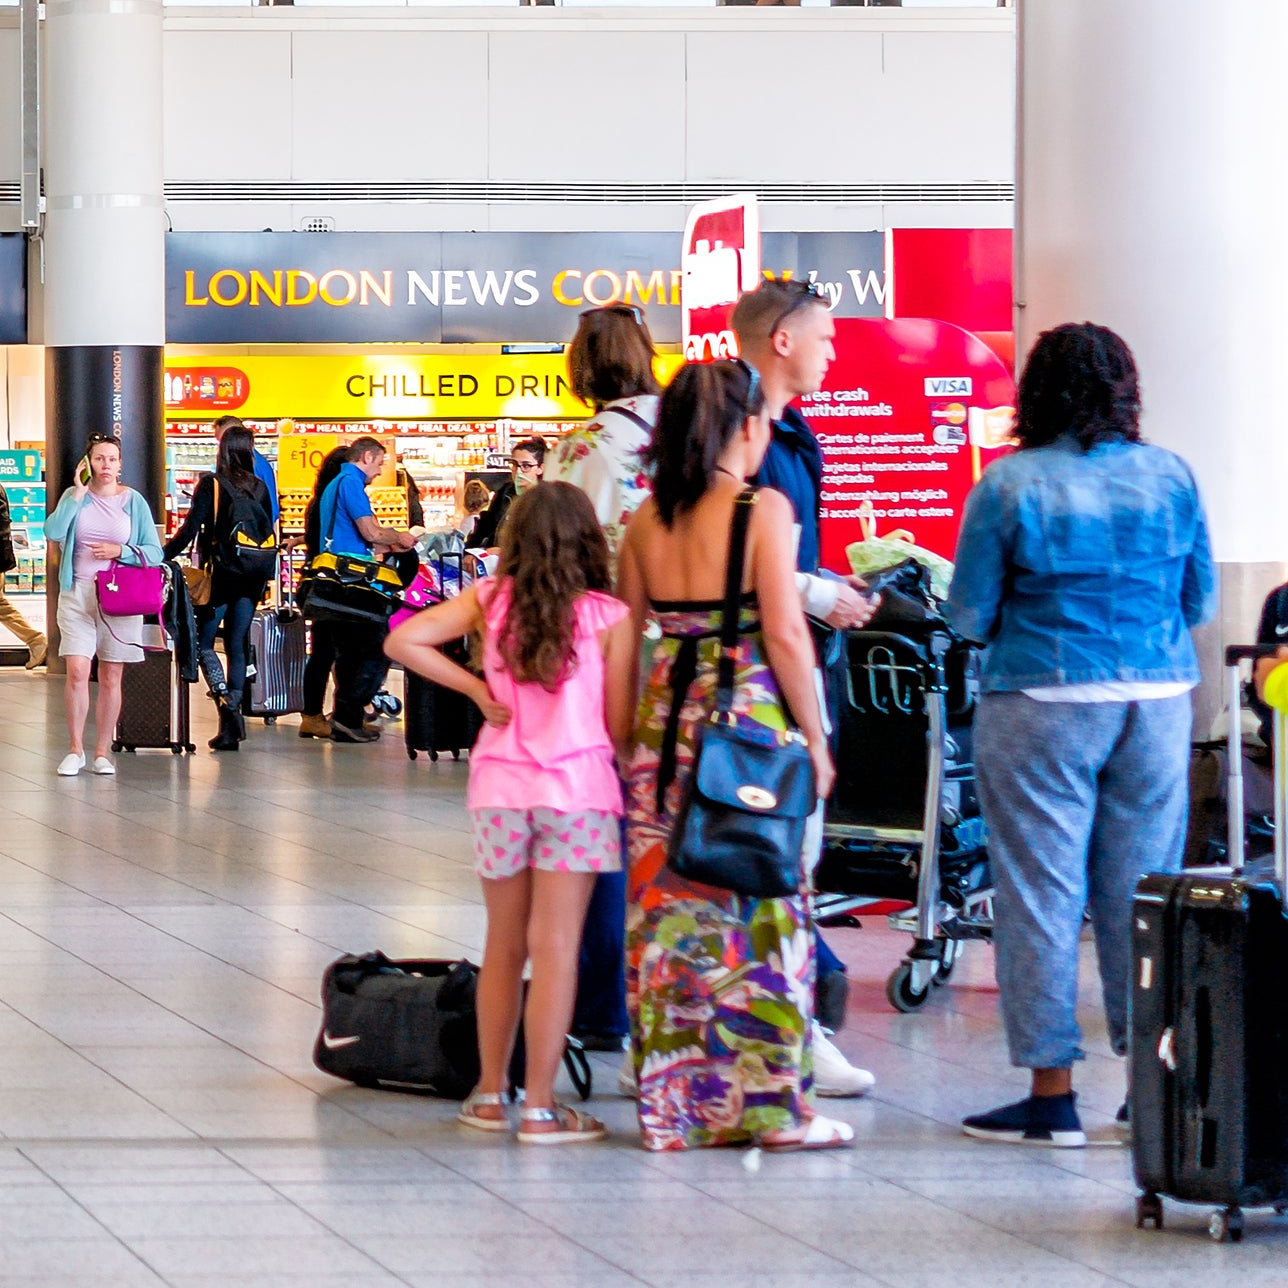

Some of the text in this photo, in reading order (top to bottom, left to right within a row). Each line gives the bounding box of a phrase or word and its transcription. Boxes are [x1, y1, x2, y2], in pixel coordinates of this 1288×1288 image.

[184, 269, 393, 308] LONDON
[407, 269, 540, 307] NEWS
[346, 374, 479, 398] CHILLED
[930, 379, 968, 393] VISA
[112, 349, 123, 440] LONDON NEWS CO
[833, 388, 869, 402] cash
[801, 402, 893, 418] withdrawals
[316, 423, 344, 433] MEAL
[344, 423, 372, 433] DEAL
[418, 423, 445, 433] MEAL
[447, 423, 474, 433] DEAL
[300, 438, 308, 449] 3
[854, 432, 870, 444] de
[871, 432, 925, 445] paiement
[820, 444, 900, 455] nternationales
[887, 507, 917, 518] carte
[918, 507, 954, 517] estere
